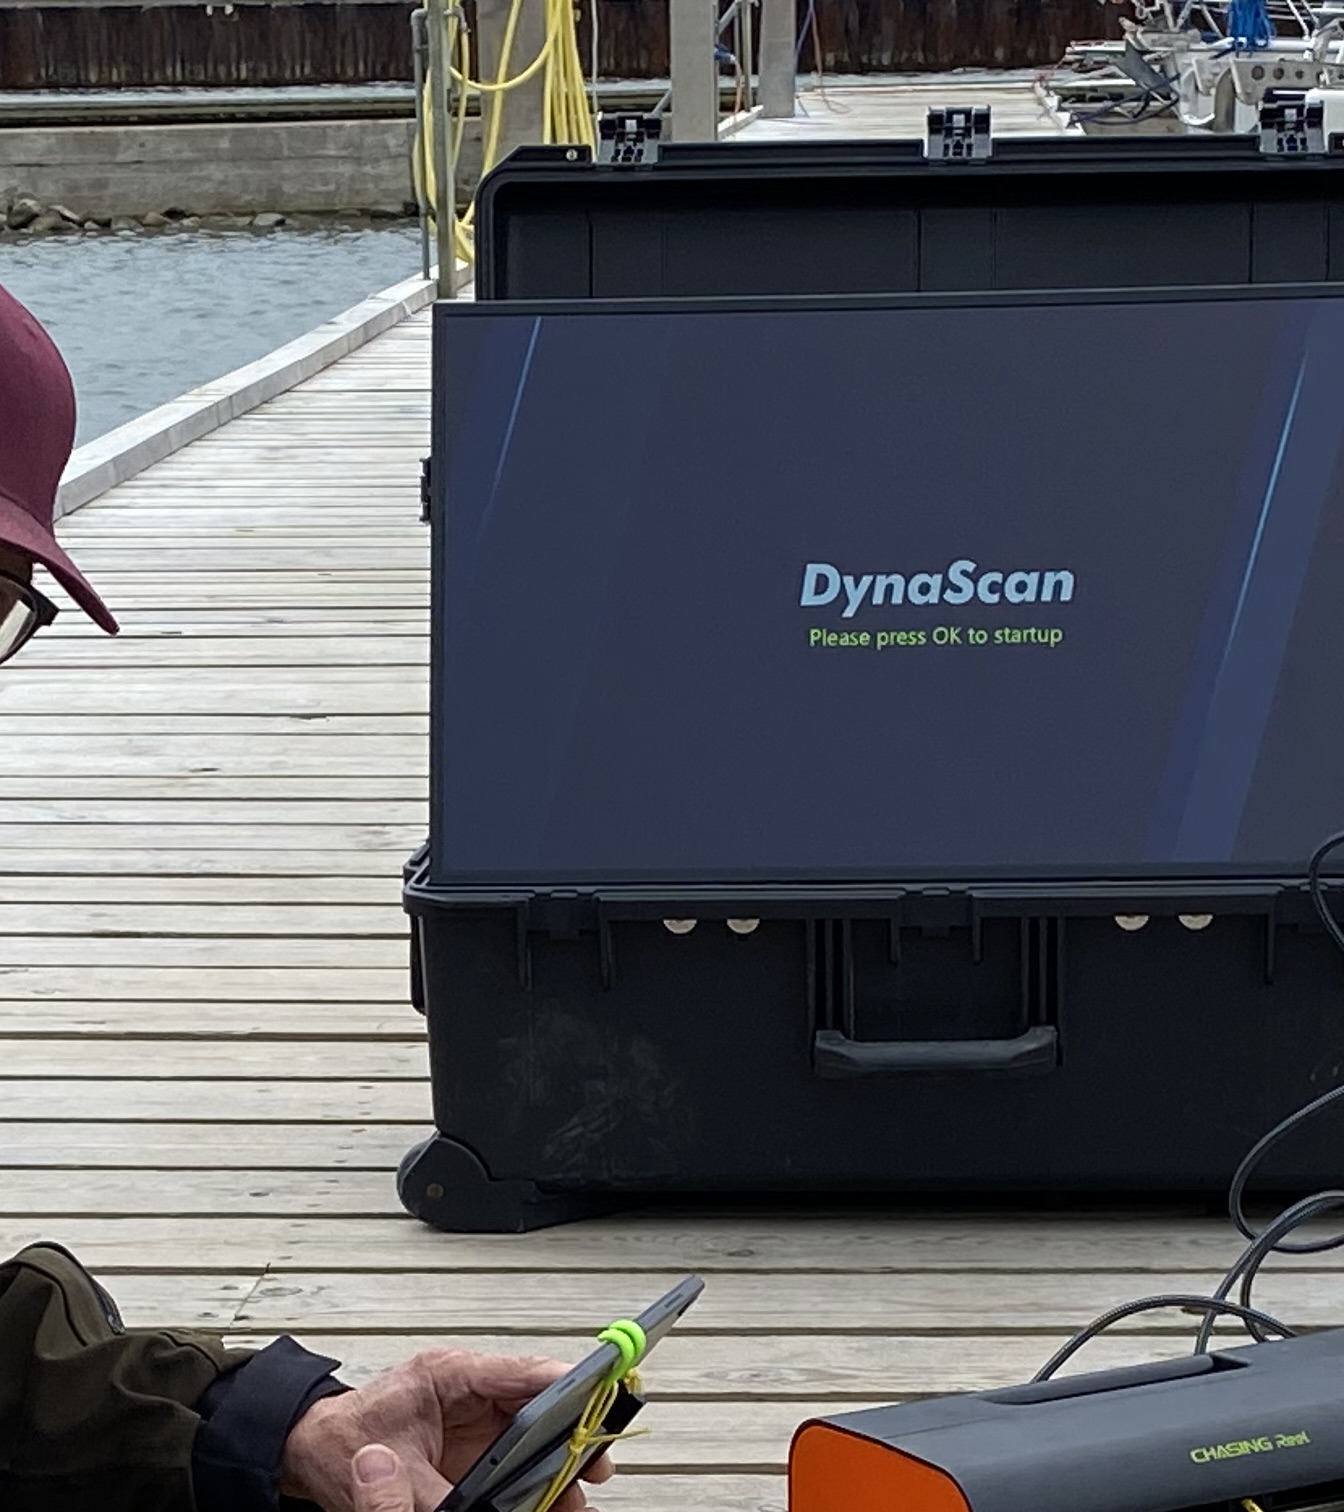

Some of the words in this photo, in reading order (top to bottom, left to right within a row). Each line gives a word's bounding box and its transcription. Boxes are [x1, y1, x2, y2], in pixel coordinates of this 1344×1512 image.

[800, 559, 1075, 618] DynaScan
[809, 628, 871, 648] Please
[876, 631, 927, 650] press
[932, 626, 962, 645] OK
[968, 629, 989, 645] to
[994, 626, 1063, 648] startup
[1189, 1436, 1274, 1464] CHASING
